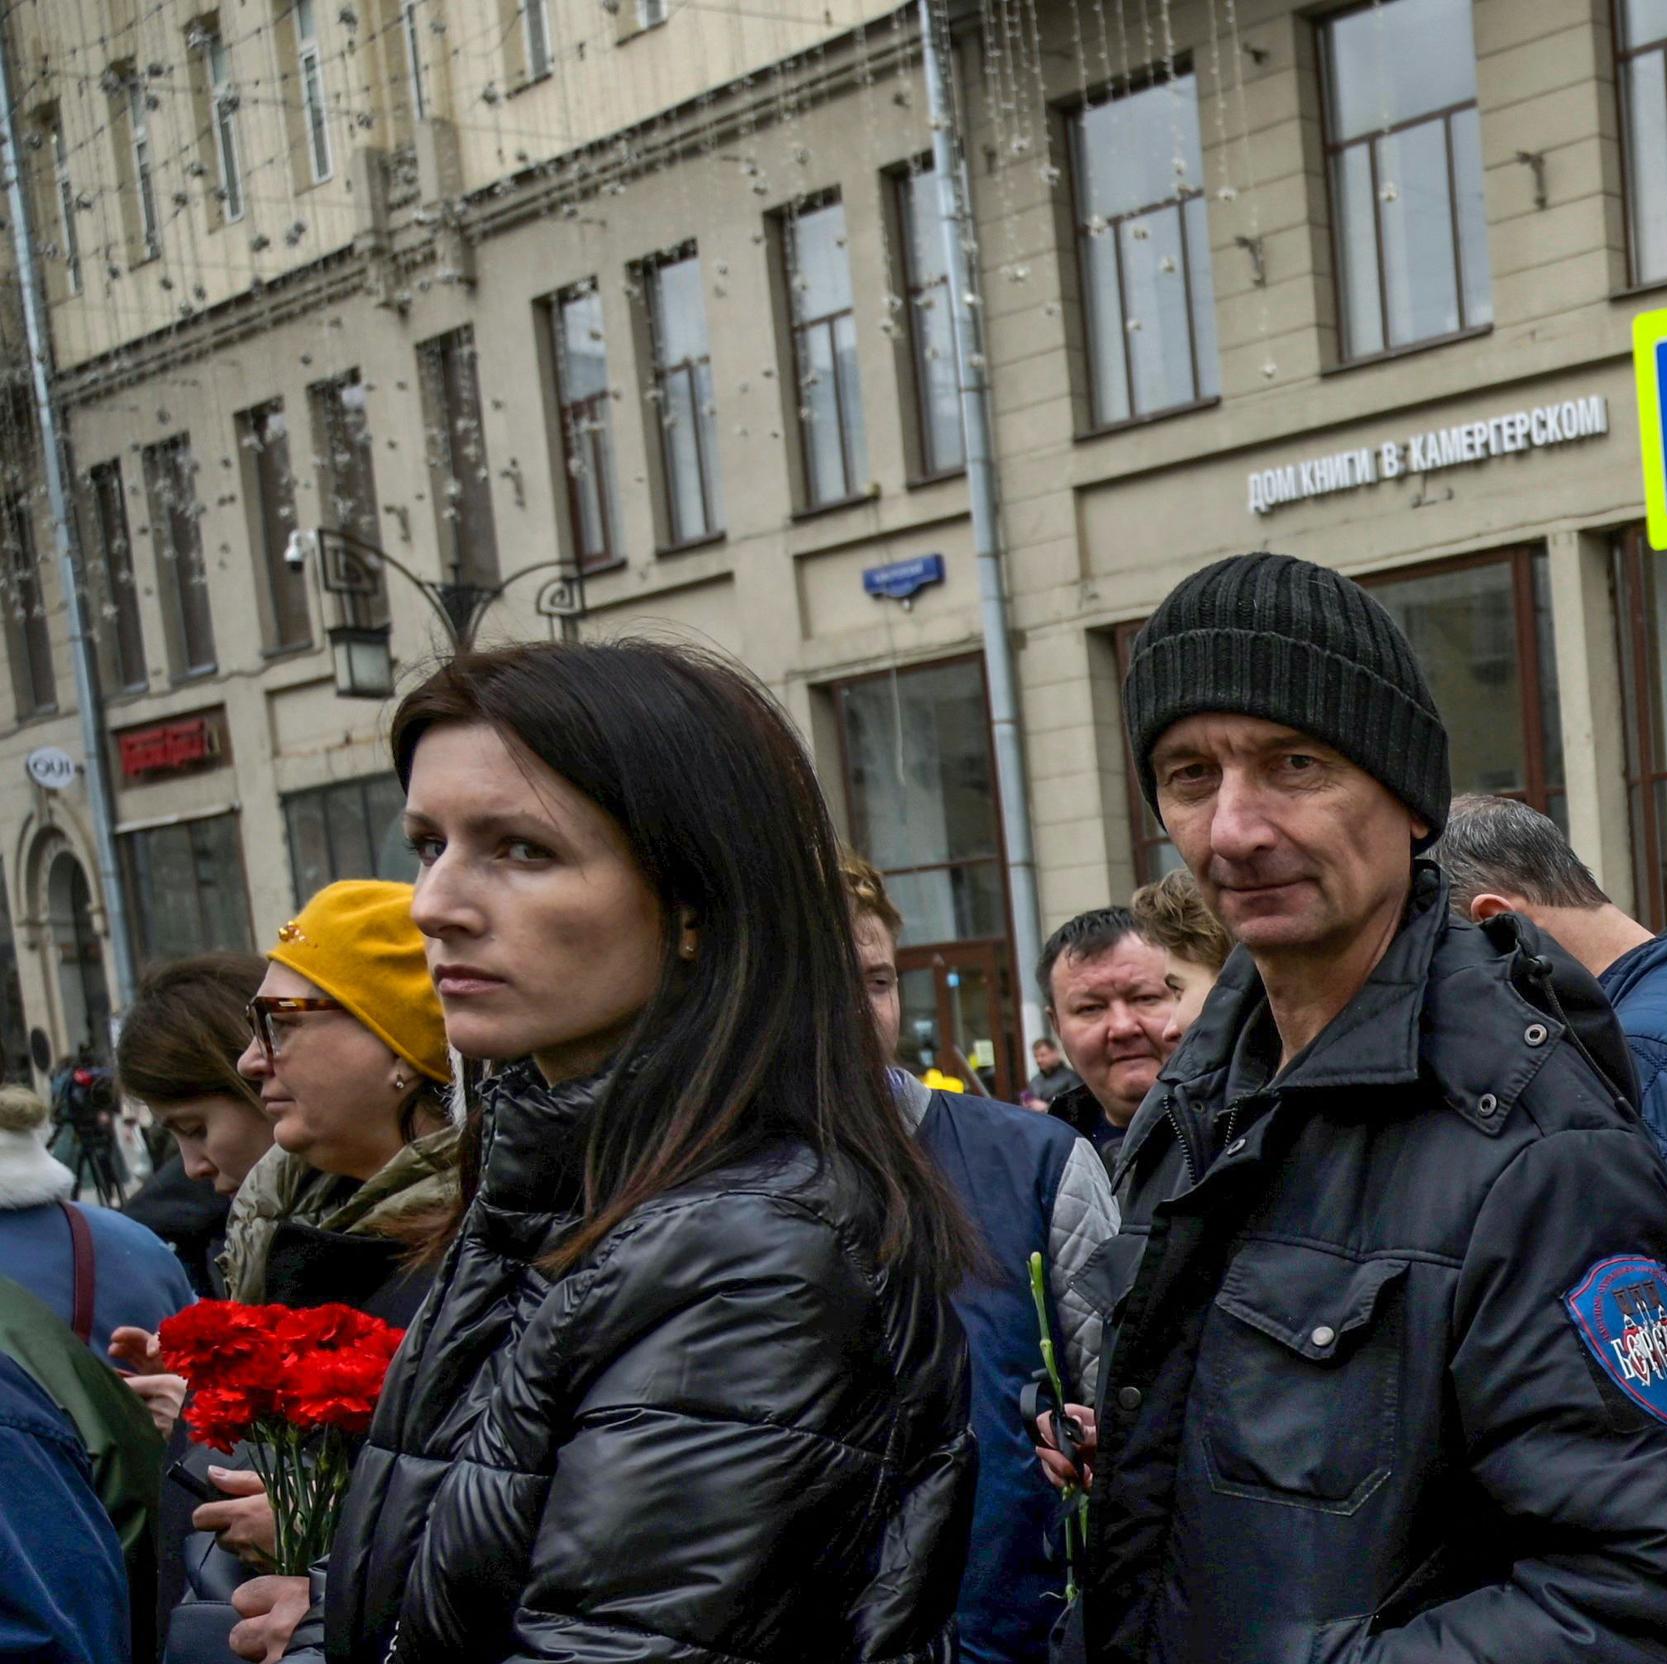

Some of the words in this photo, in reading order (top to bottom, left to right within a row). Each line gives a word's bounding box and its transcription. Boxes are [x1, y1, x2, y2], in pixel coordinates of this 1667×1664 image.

[1249, 466, 1297, 512] ДОМ
[1302, 447, 1378, 495] КНИГИ
[1381, 441, 1402, 479] В
[1410, 396, 1607, 473] КАМЕРГЕРСКОМ
